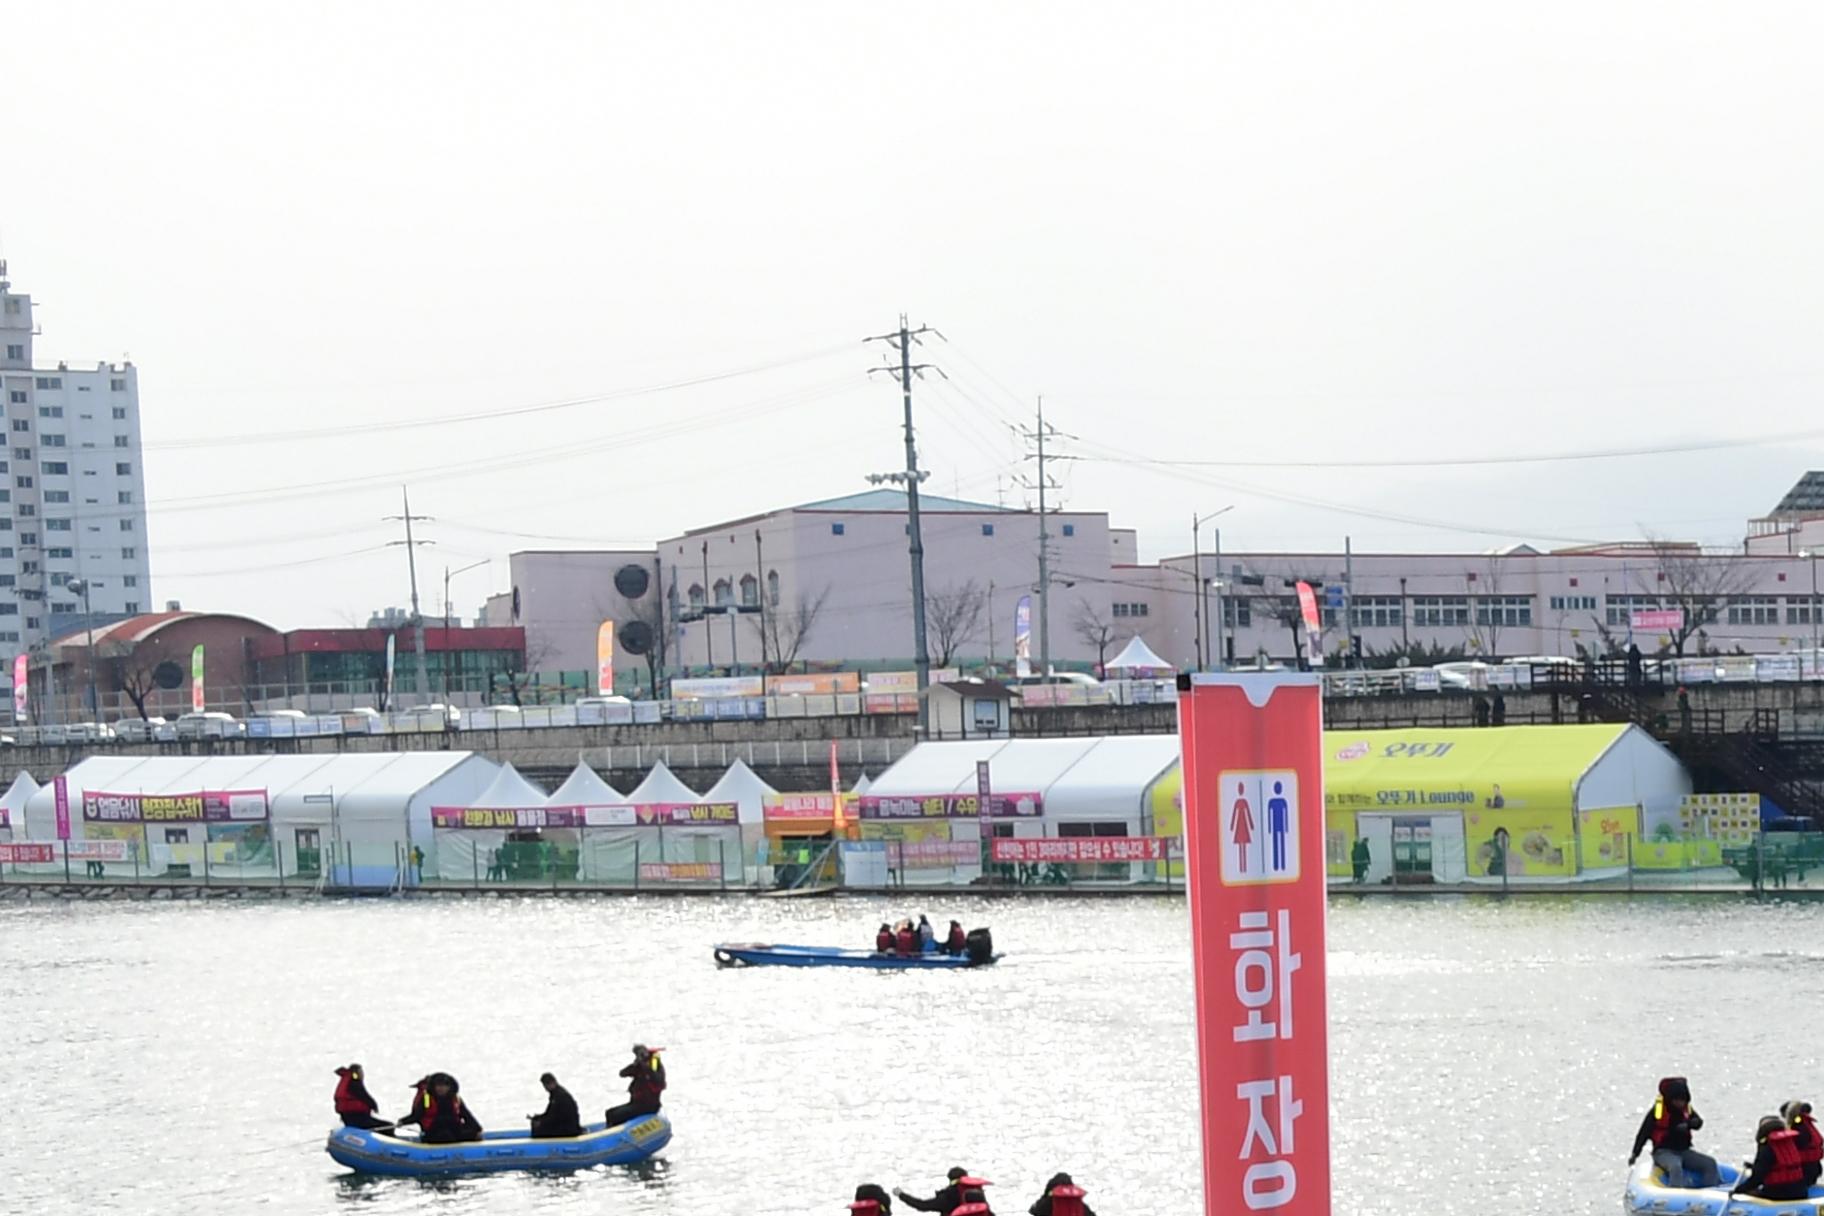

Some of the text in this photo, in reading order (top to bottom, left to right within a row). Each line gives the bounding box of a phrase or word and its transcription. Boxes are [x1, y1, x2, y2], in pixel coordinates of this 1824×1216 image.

[1379, 742, 1454, 758] 오뚜기
[1376, 789, 1416, 804] 오뚜기
[1421, 789, 1475, 804] Lounge
[956, 797, 979, 815] 수유
